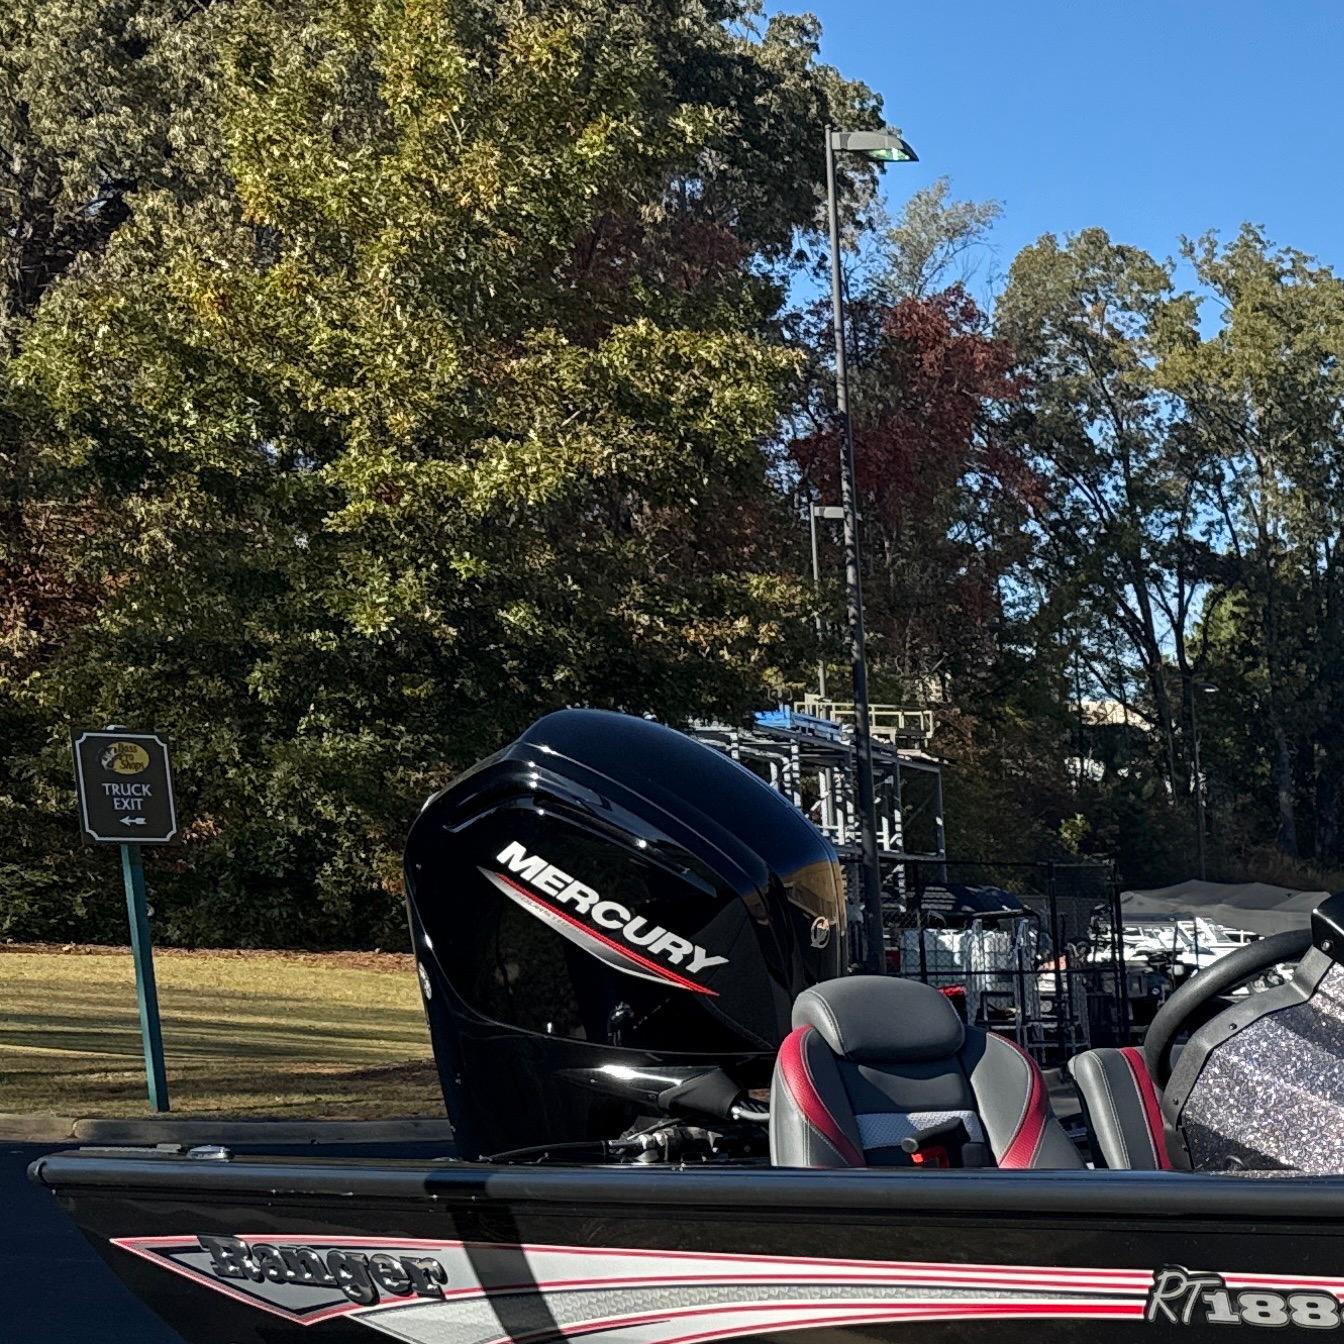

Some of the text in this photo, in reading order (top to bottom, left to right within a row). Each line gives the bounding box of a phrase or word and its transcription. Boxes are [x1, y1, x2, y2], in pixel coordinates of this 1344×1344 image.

[102, 783, 152, 796] TRUCK
[113, 798, 144, 810] EXIT
[496, 841, 730, 973] MERCURY
[197, 1233, 449, 1306] Ranger
